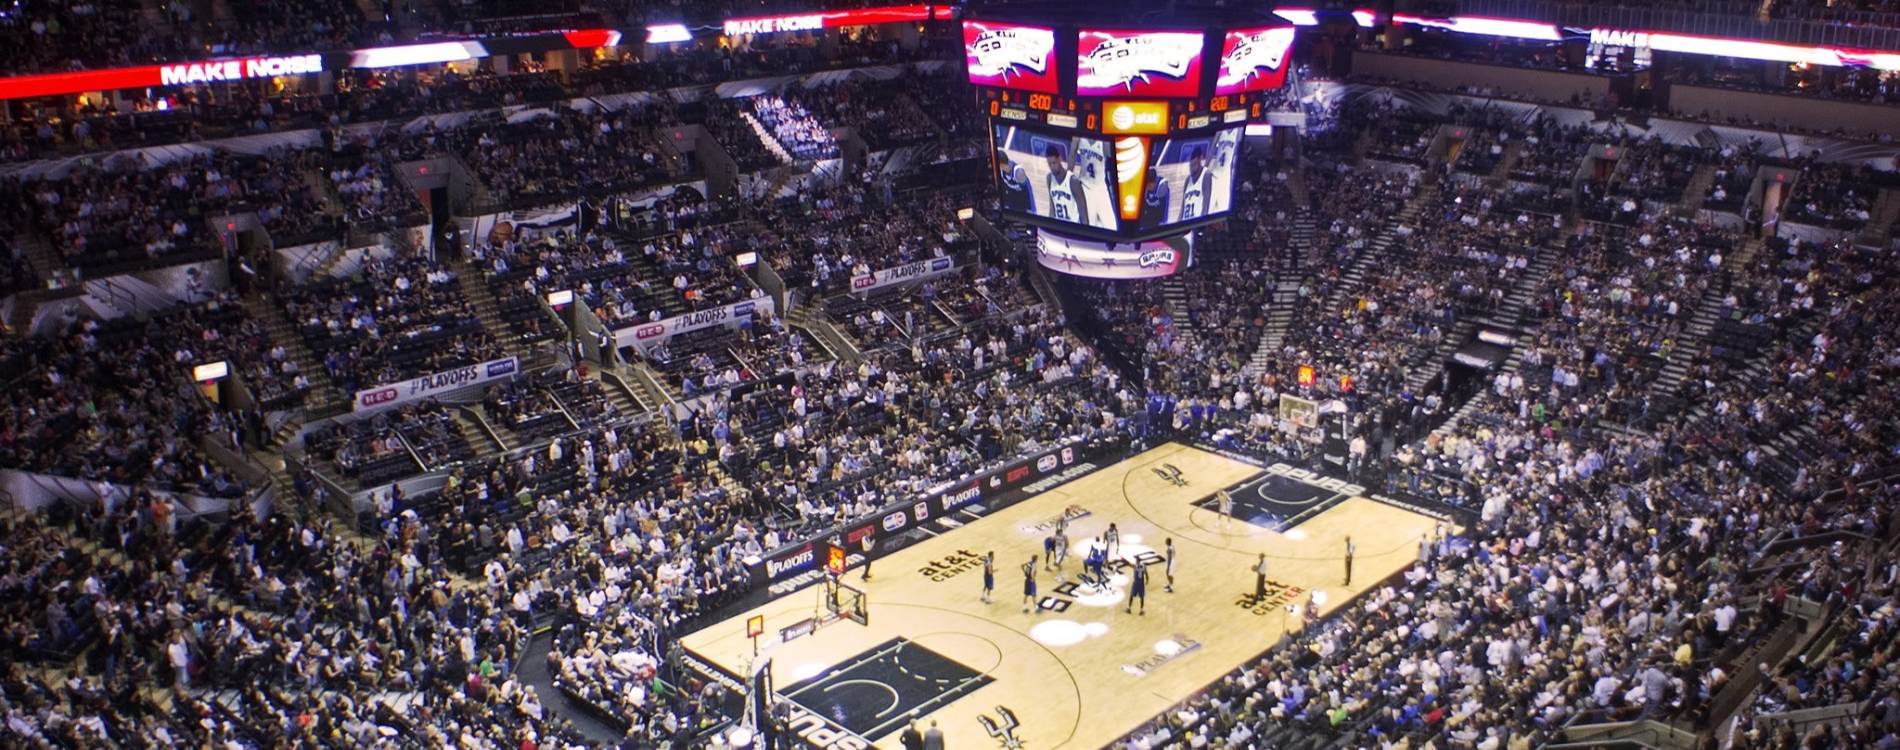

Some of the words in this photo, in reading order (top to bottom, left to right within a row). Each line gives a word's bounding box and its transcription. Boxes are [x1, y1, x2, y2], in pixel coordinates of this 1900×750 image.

[725, 20, 772, 35] MAKE
[1590, 29, 1648, 47] MAKE
[160, 62, 241, 84] MAKE
[246, 55, 322, 77] NOISE
[1086, 162, 1095, 178] 4
[1056, 203, 1071, 219] 21
[891, 262, 926, 280] PLAYOFFS
[682, 307, 727, 328] PLAYOFFS
[421, 366, 478, 391] PLAYOFFS
[1268, 462, 1367, 496] SPURS
[948, 486, 980, 507] PLAYOFFS
[774, 551, 813, 572] PLAYOFFS
[918, 550, 979, 576] at&t
[1252, 586, 1305, 616] CENTER
